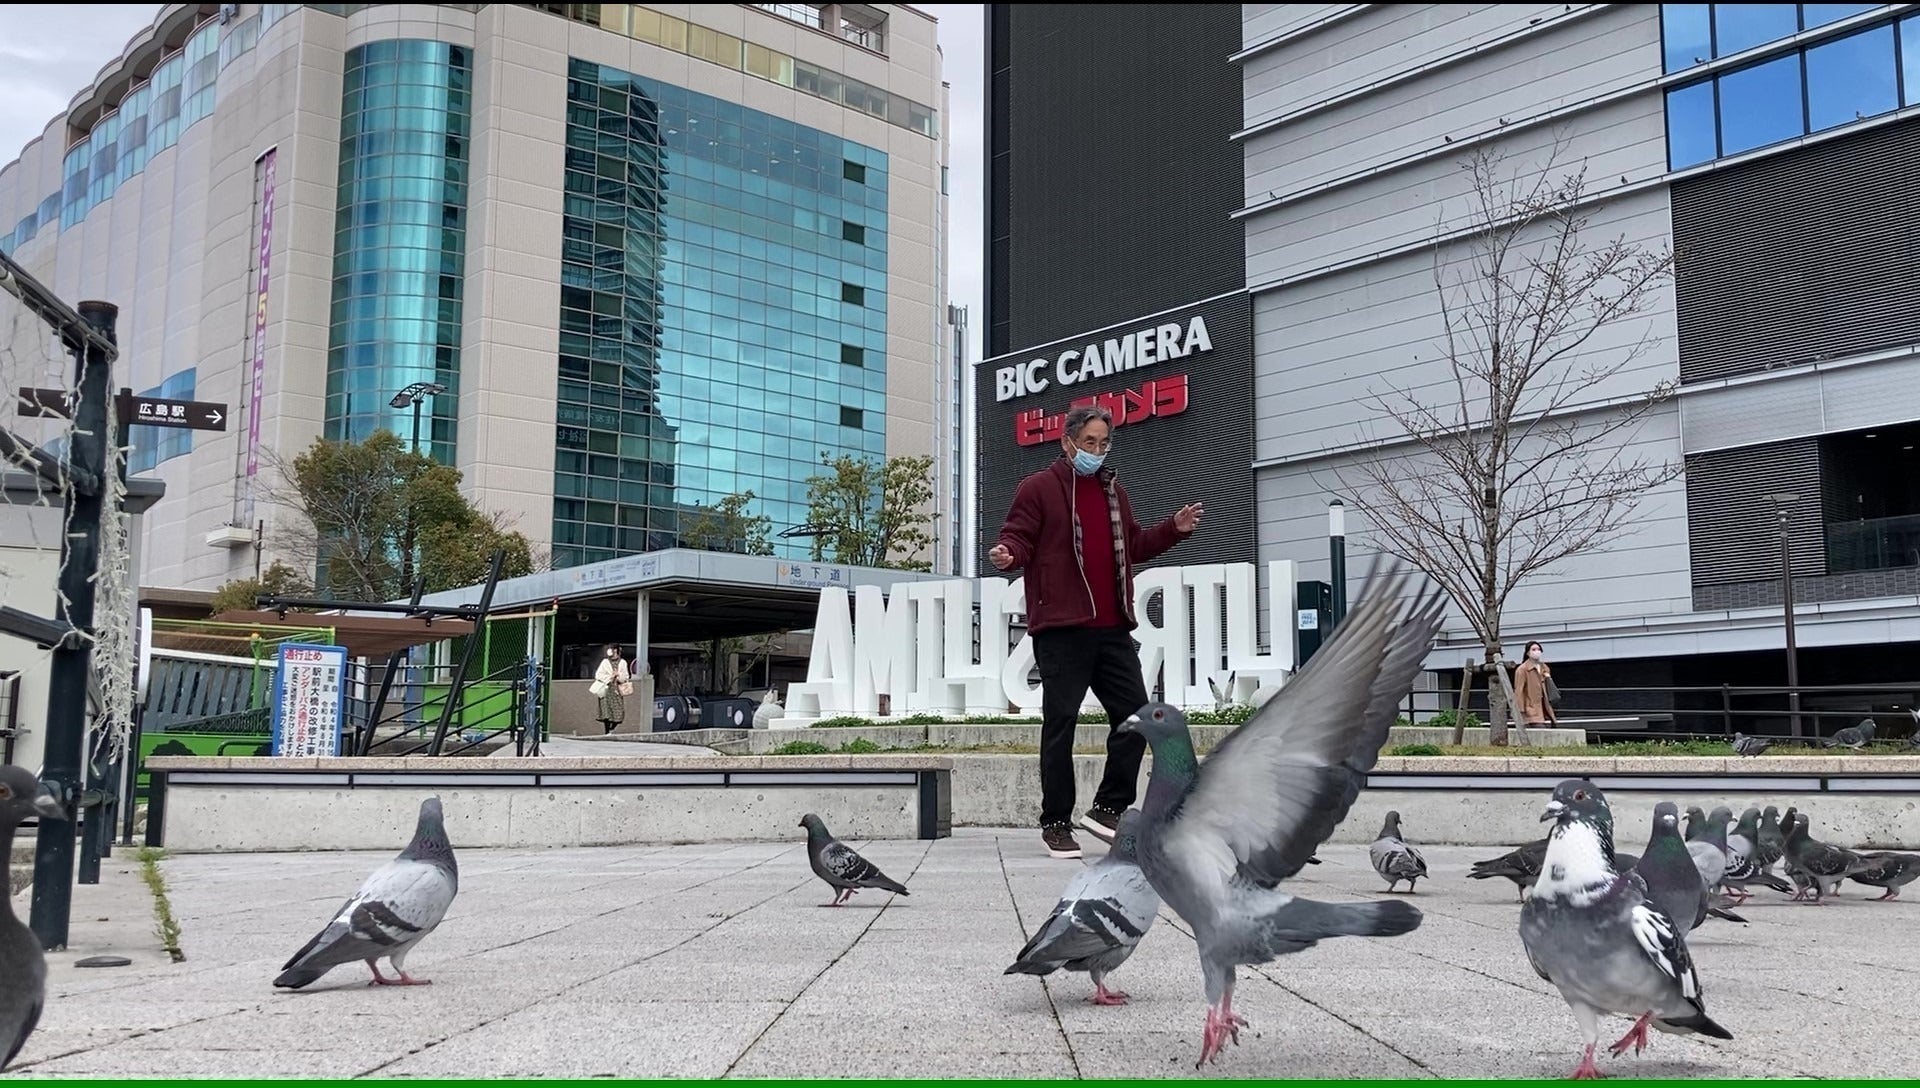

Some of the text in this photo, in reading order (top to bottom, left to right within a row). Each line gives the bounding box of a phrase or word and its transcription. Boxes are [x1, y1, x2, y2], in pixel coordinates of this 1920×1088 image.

[995, 316, 1214, 402] BIC CAMERA
[138, 402, 185, 417] 広島駅
[138, 414, 167, 422] Hiroshima
[1015, 373, 1189, 446] ビッカメラ
[790, 564, 841, 581] 地下道
[285, 648, 323, 662] 通行止め
[306, 667, 322, 756] 駅前大橋の改修工事
